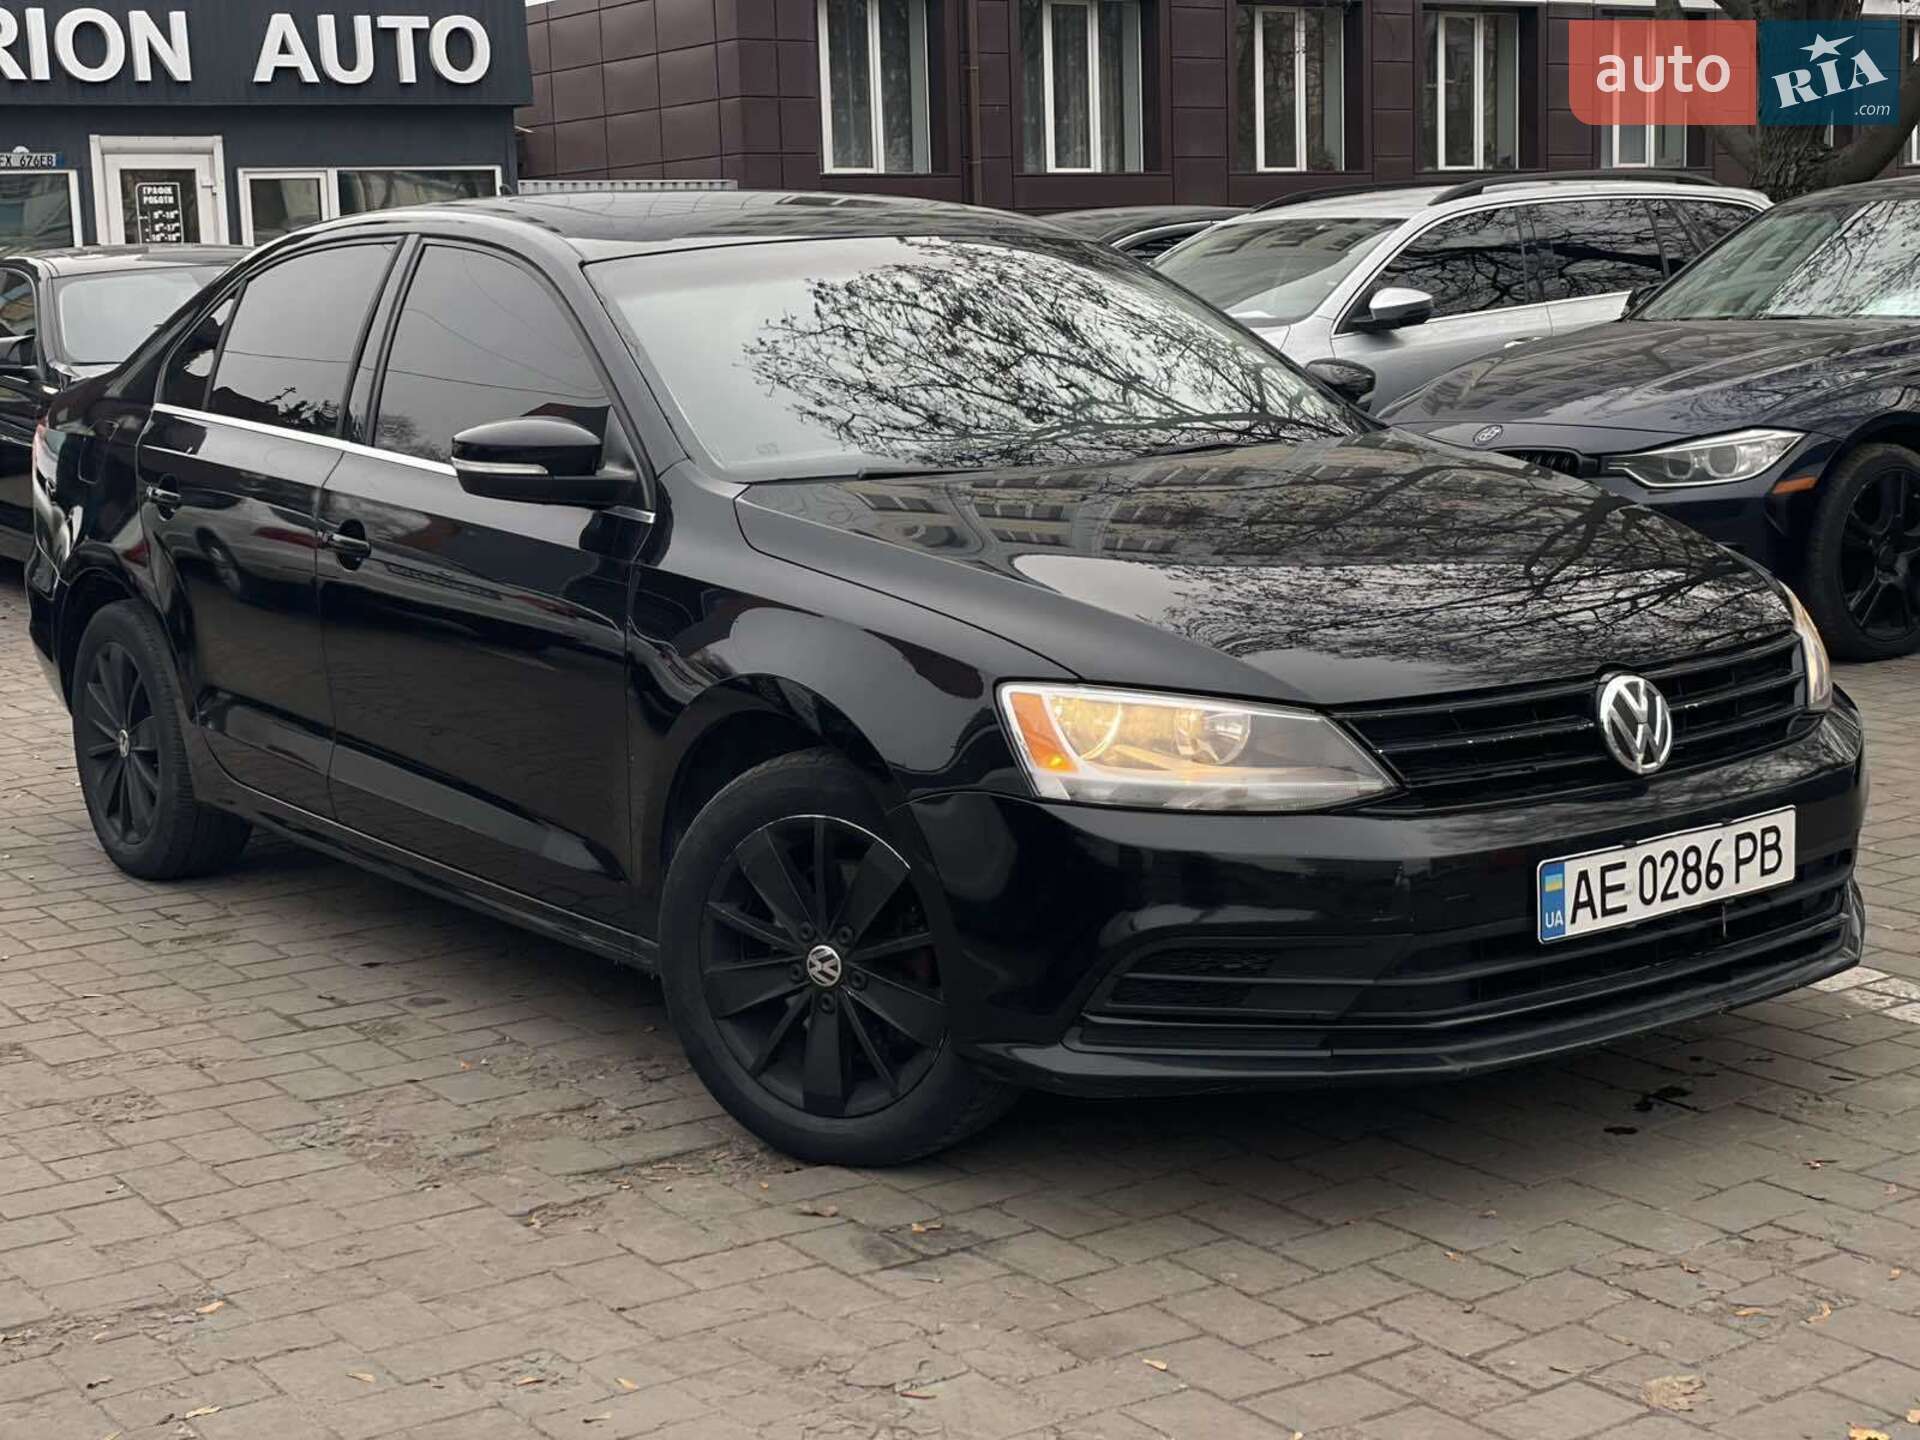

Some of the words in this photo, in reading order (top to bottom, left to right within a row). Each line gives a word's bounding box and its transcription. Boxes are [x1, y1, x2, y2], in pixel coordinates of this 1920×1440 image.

[253, 13, 491, 84] AUTO
[1570, 861, 1628, 925] AE
[1637, 838, 1724, 906] 0286
[1734, 825, 1783, 884] PB
[1545, 911, 1564, 928] UA
